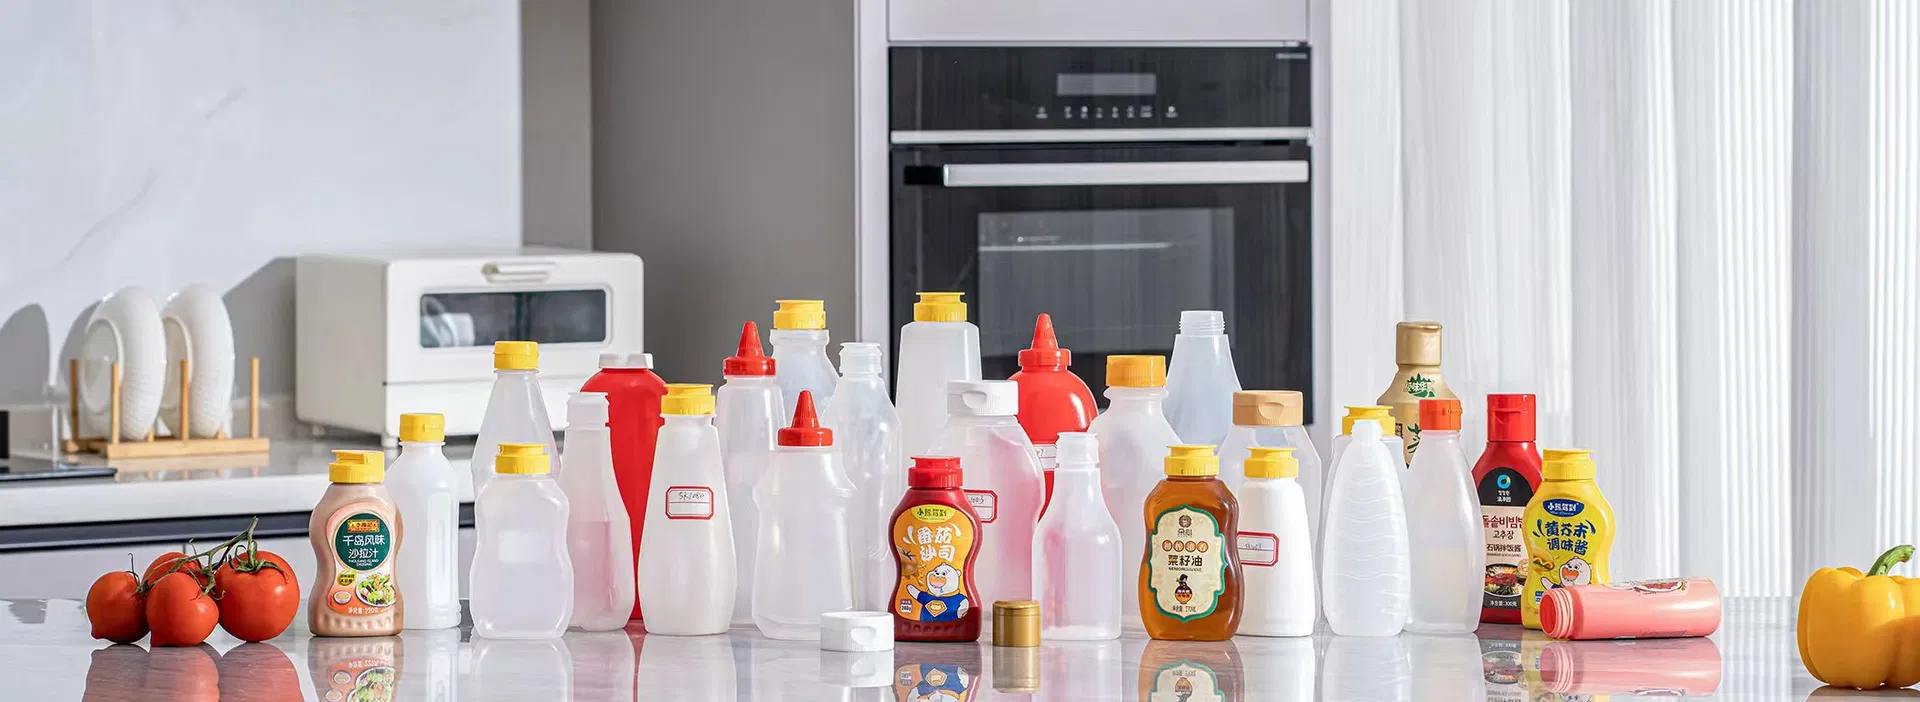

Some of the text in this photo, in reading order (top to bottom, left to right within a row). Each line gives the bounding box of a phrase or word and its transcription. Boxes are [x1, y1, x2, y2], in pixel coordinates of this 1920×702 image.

[917, 526, 953, 545] 番茄
[1492, 530, 1515, 541] 고추장
[1545, 520, 1589, 539] 黄芥末
[342, 534, 386, 547] 千岛风味
[1546, 537, 1589, 556] 调味酱
[348, 547, 379, 559] 沙拉汁
[920, 544, 956, 563] 沙司
[1486, 543, 1522, 553] 石锅拌饭酱
[1167, 554, 1203, 567] 菜籽油
